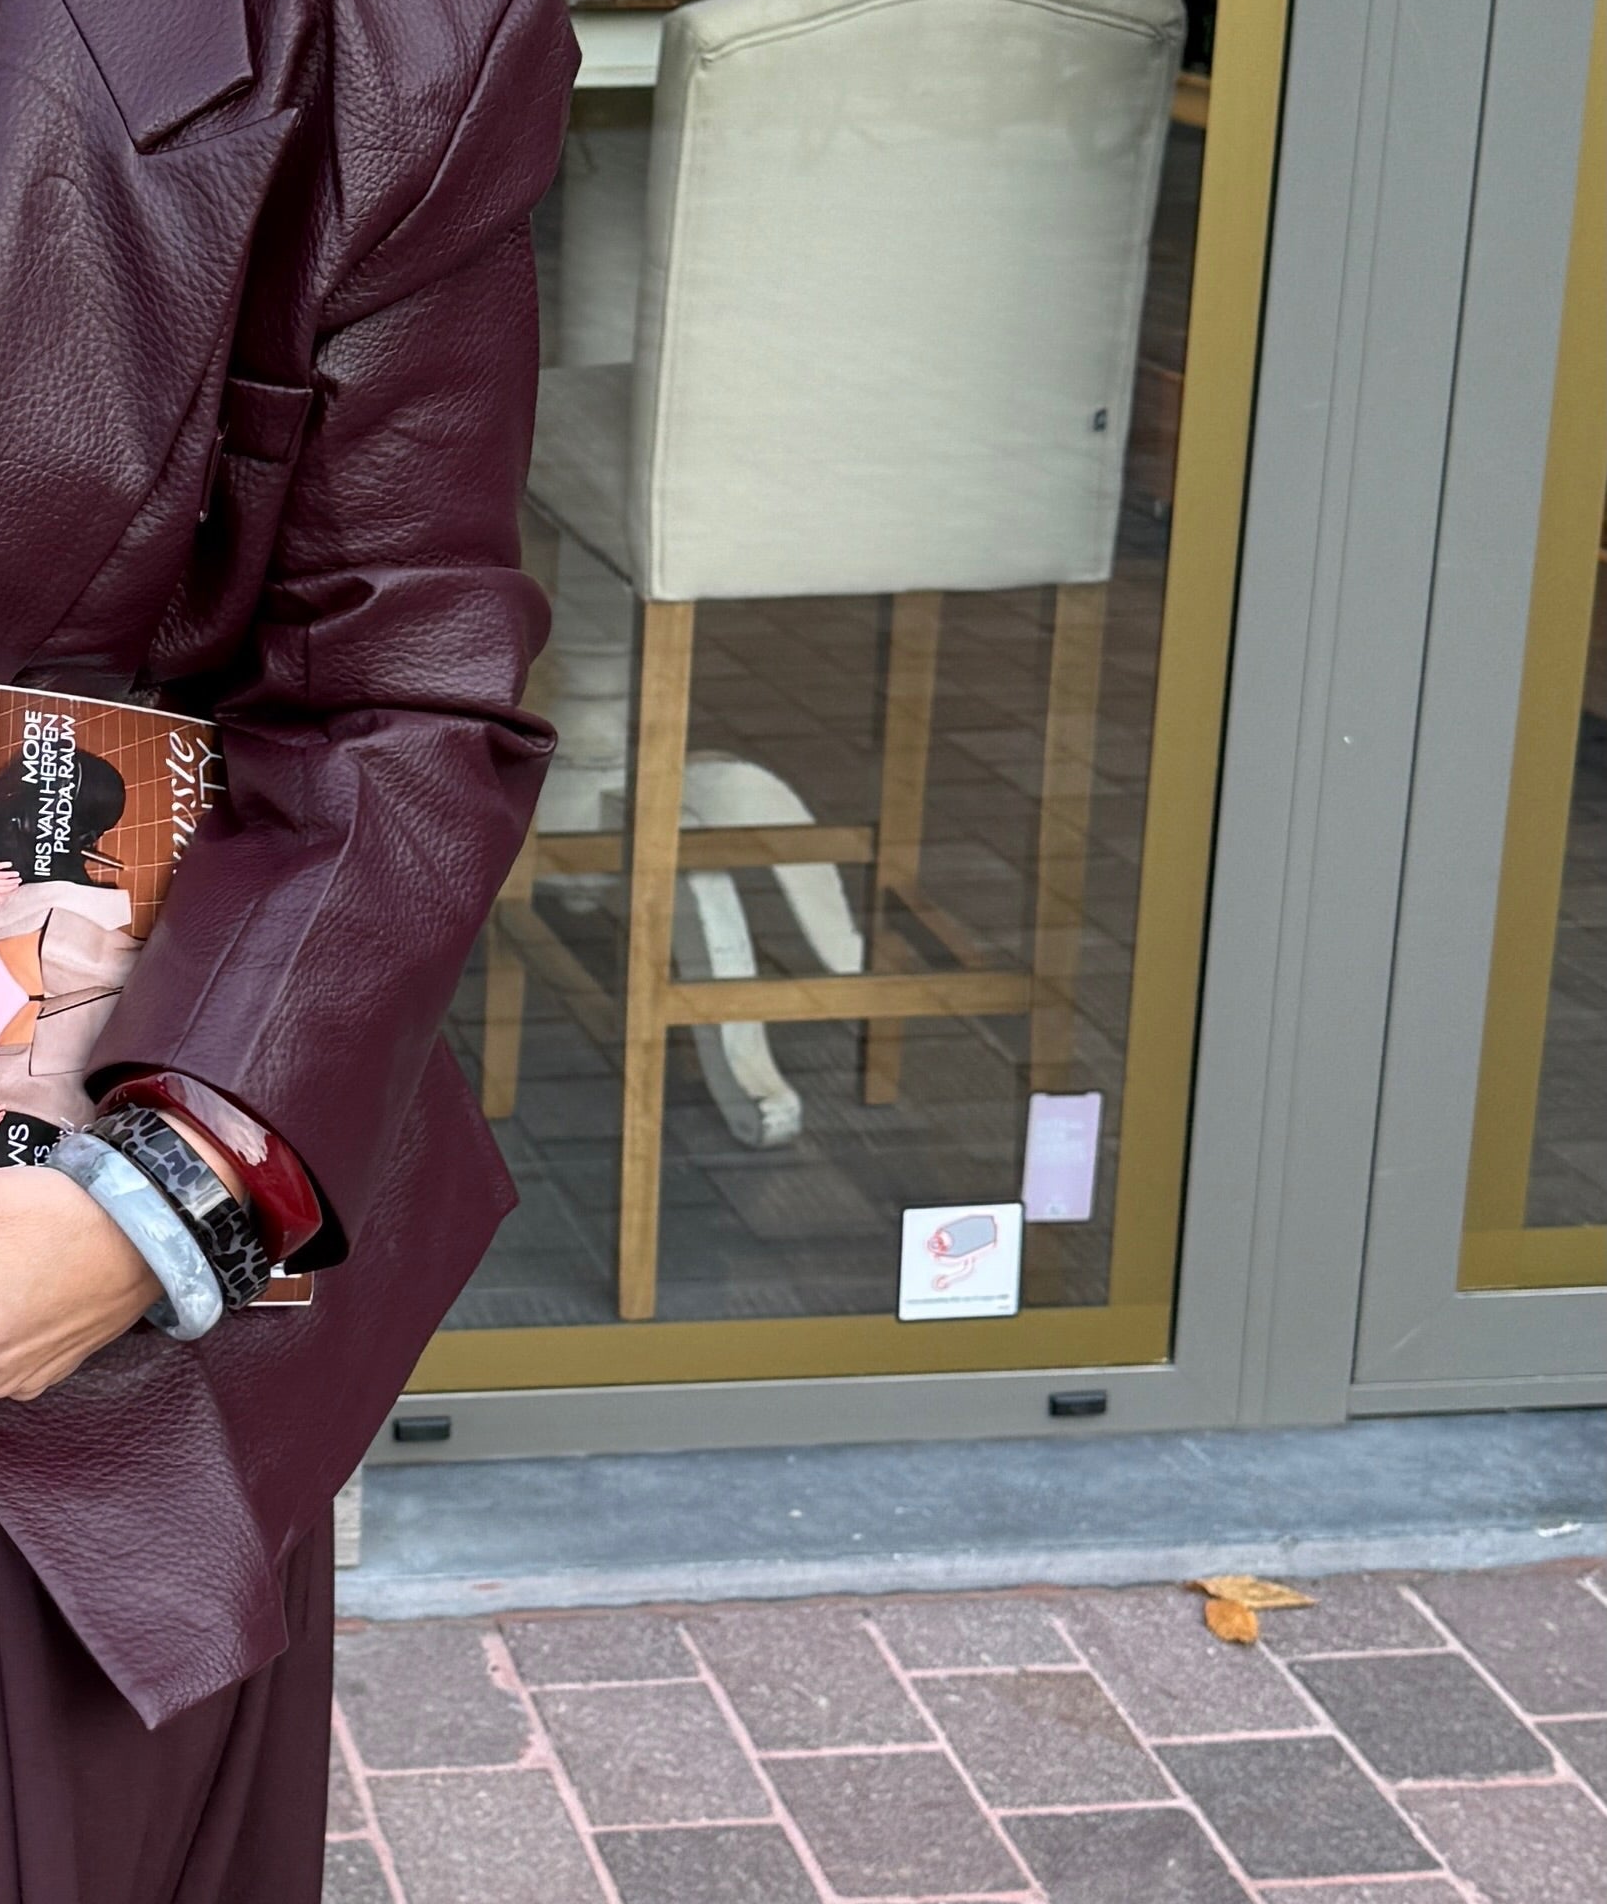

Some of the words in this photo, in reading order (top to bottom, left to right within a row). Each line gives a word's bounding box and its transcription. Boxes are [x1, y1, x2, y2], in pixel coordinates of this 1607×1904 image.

[21, 709, 42, 784] MODE
[39, 713, 60, 795] HERPEN
[58, 713, 76, 779] RAUW
[36, 797, 56, 840] VAN
[34, 842, 53, 877] IRIS
